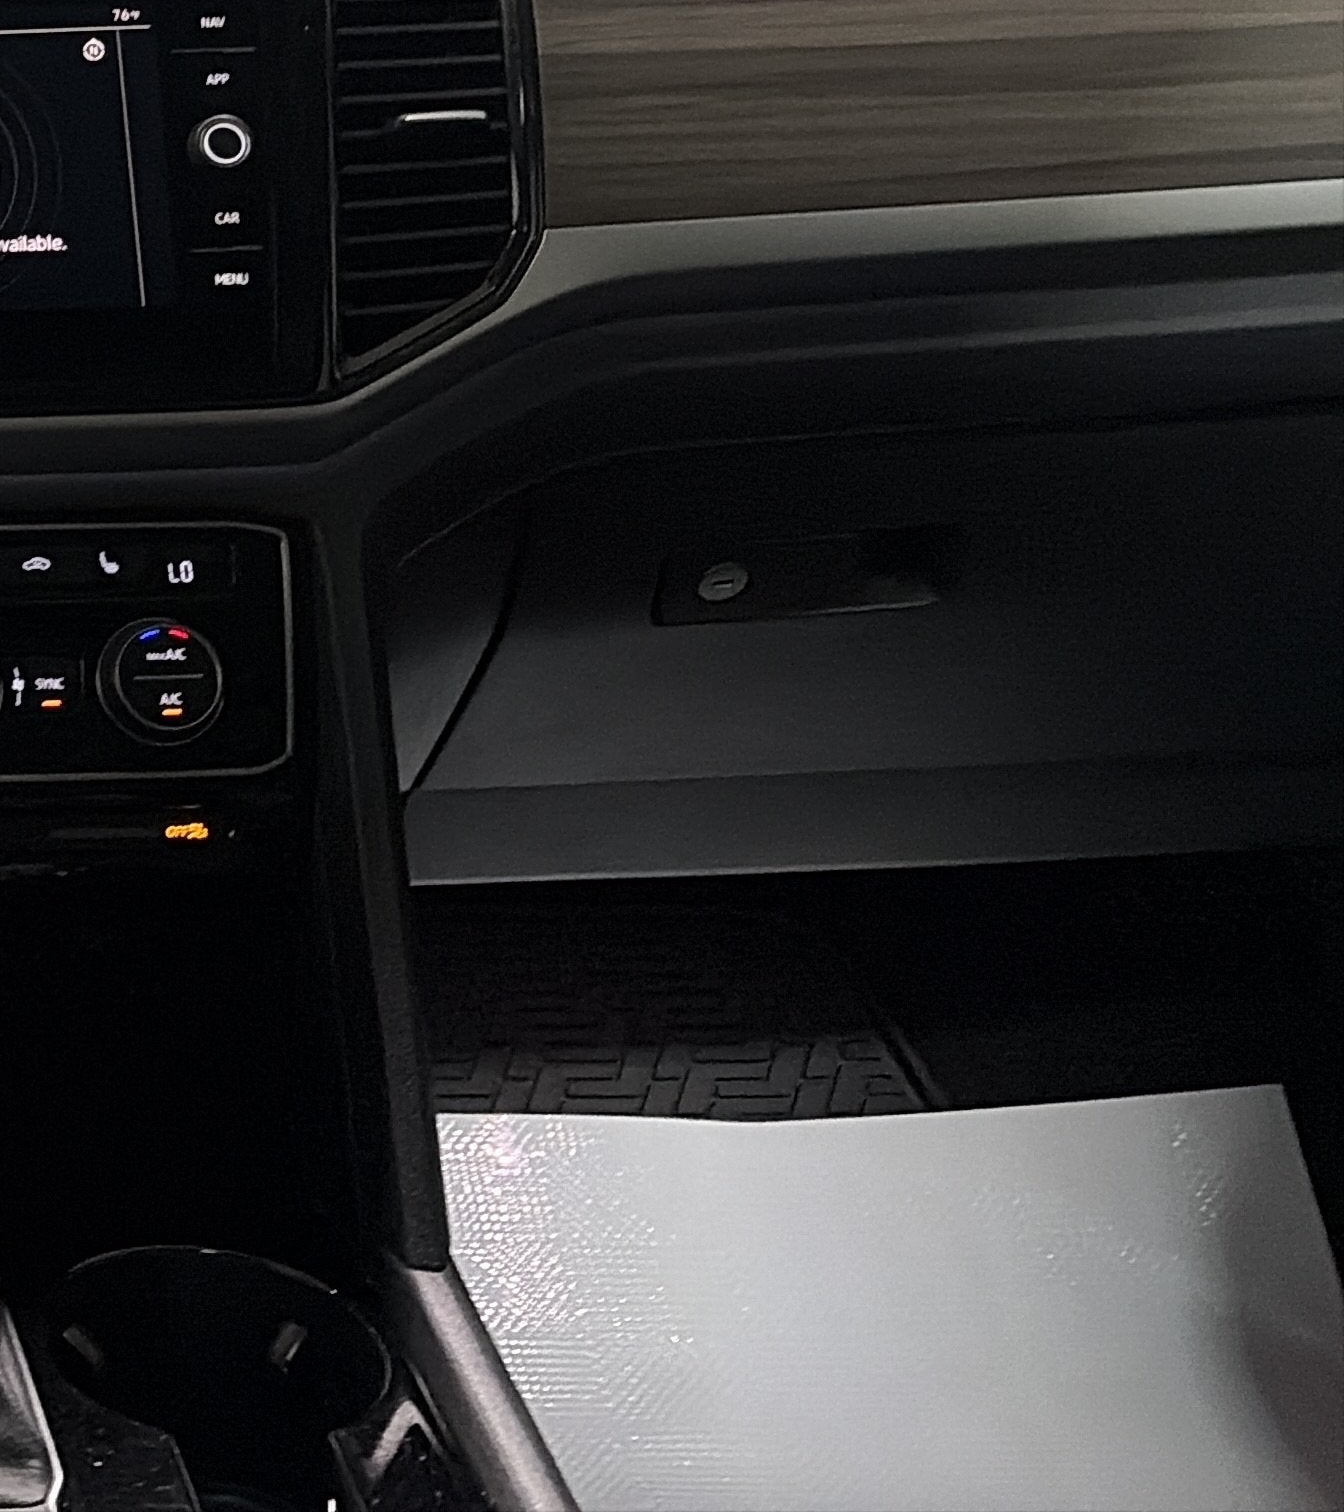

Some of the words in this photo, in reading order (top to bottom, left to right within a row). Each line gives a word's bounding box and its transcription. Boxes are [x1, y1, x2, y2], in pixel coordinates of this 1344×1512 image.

[205, 72, 230, 86] APP
[214, 211, 241, 225] CAR
[214, 271, 250, 286] MENU
[34, 677, 65, 691] SYNC
